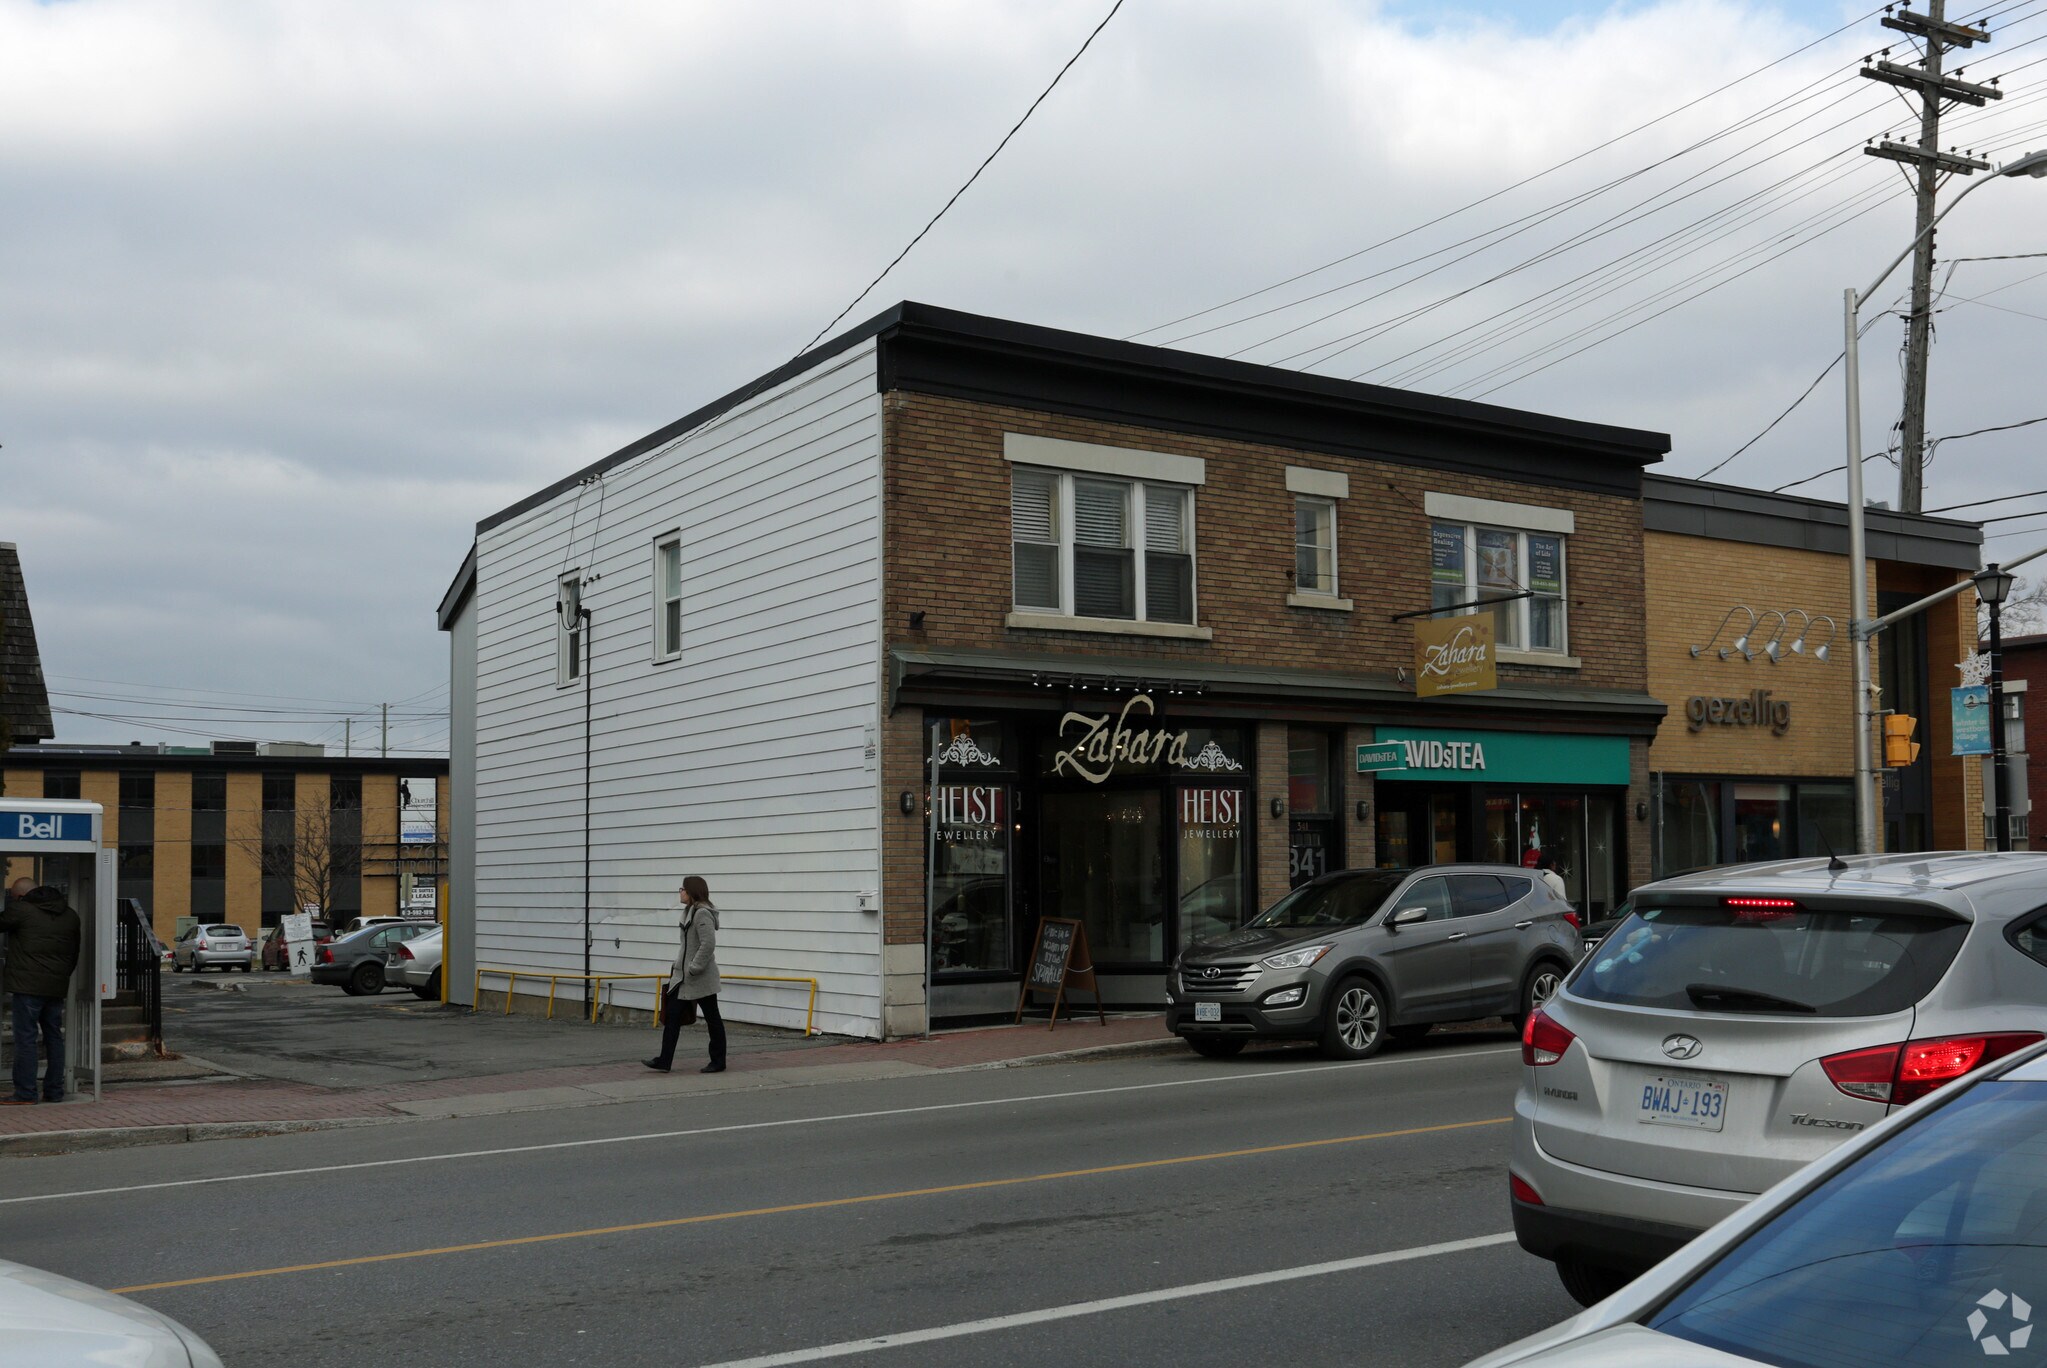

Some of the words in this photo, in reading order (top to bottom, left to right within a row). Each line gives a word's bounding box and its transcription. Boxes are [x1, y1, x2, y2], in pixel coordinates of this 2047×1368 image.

[1420, 626, 1487, 678] Zahara
[1686, 689, 1790, 737] gezellig
[1051, 694, 1188, 784] Zahara
[1359, 752, 1397, 763] DAVIDsTEA
[1387, 739, 1486, 770] AVIDsTEA
[1184, 789, 1243, 824] HEIST
[19, 814, 62, 838] Bell
[936, 831, 997, 840] EWELLERY
[1184, 830, 1241, 839] JEWELLERY
[401, 845, 436, 859] 376
[1290, 847, 1326, 878] 341
[1667, 1079, 1702, 1089] ONTARIO
[1790, 1113, 1865, 1131] Tucson
